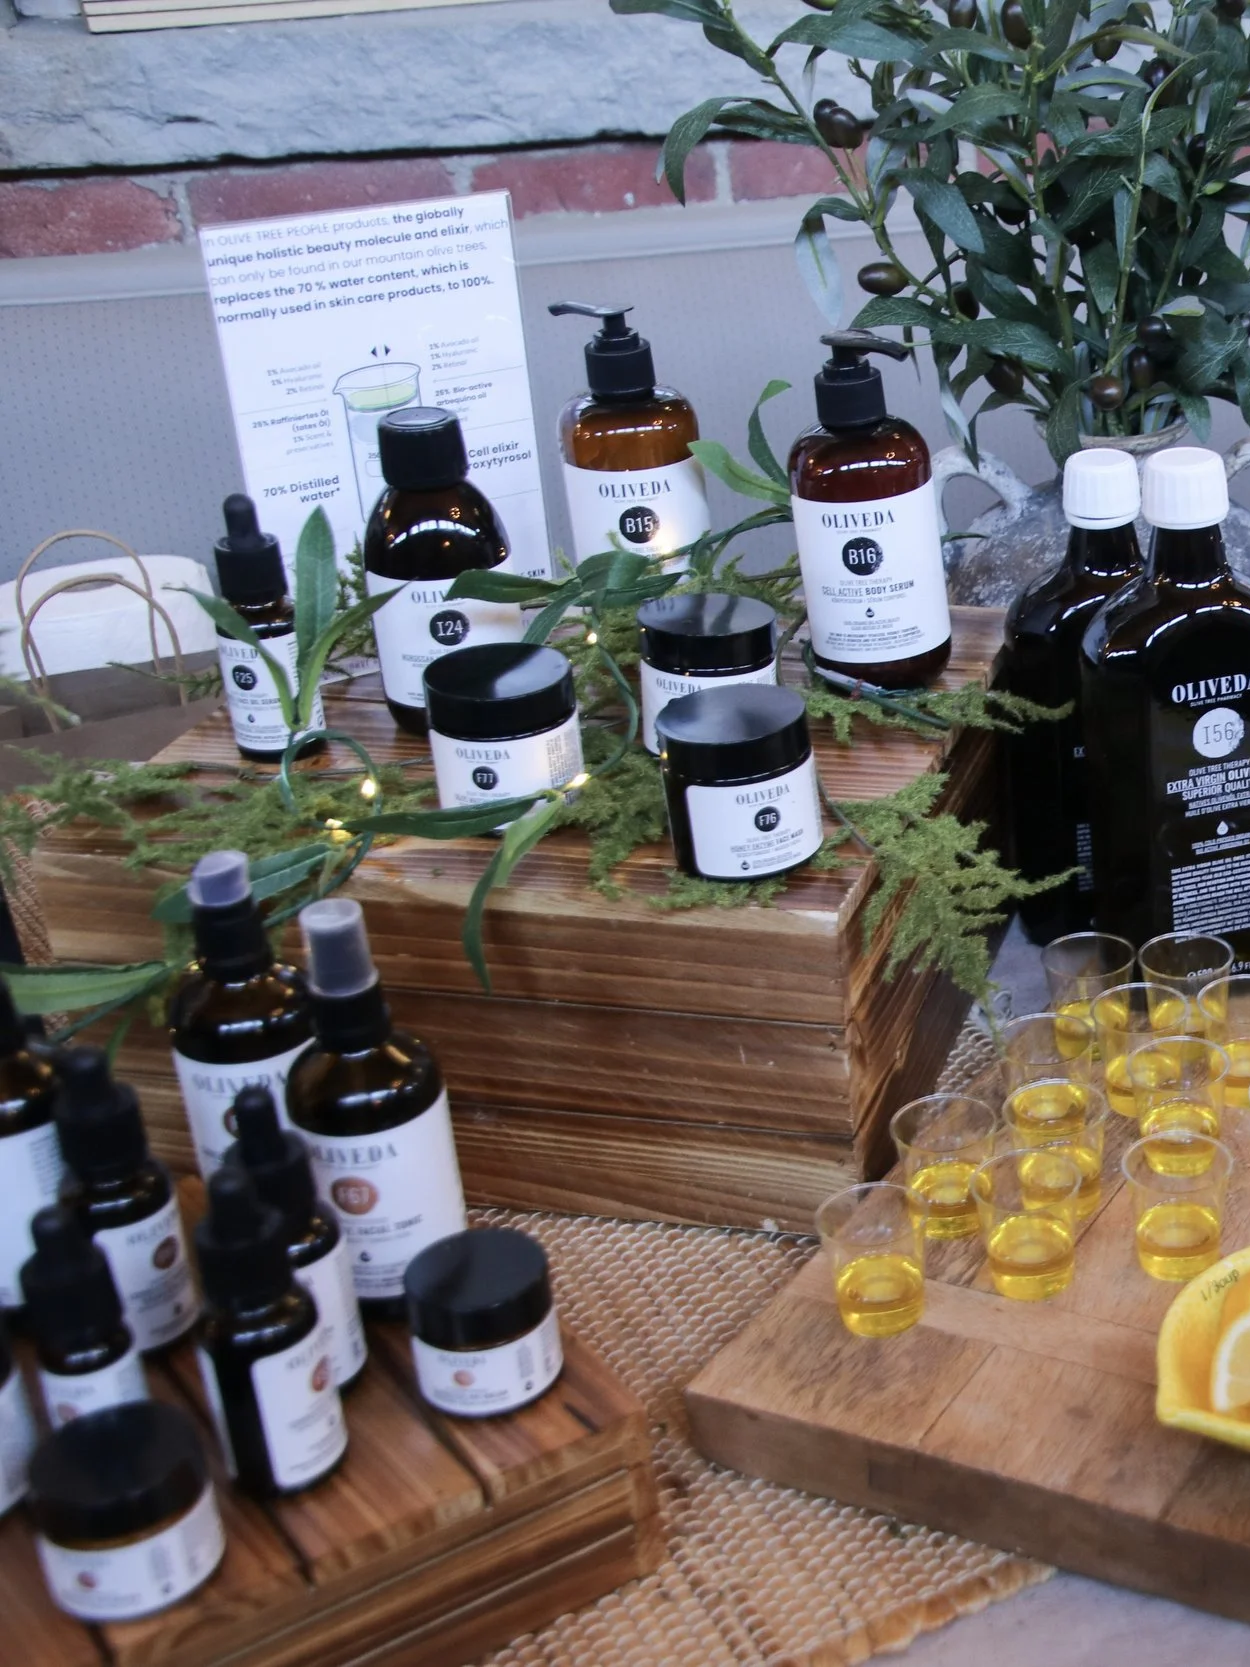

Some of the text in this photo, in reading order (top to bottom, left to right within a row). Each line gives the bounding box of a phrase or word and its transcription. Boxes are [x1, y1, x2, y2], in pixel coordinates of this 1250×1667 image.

[218, 233, 252, 247] OLIVE
[256, 228, 284, 241] TREE
[287, 223, 329, 239] PEOPLE
[393, 211, 414, 225] the
[416, 206, 465, 225] globally
[207, 219, 509, 271] unique holistic beauty molecule and elixir, which
[210, 275, 237, 287] can
[239, 270, 267, 286] only
[269, 266, 286, 280] be
[288, 260, 326, 277] found
[328, 259, 340, 271] in
[342, 257, 364, 270] our
[365, 247, 425, 266] mountain
[426, 243, 454, 258] olive
[214, 260, 470, 307] replaces the 70 % water content, which is
[217, 305, 278, 325] normally
[280, 300, 313, 317] used
[314, 298, 327, 311] in
[329, 292, 356, 308] skin
[357, 290, 385, 305] care
[388, 282, 447, 302] products,
[447, 279, 460, 291] to
[468, 441, 520, 459] Cell elixir
[467, 450, 532, 472] roxytyrosol
[263, 475, 341, 498] 70% Distilled
[599, 479, 672, 498] OLIVEDA
[625, 516, 654, 533] B15
[822, 509, 895, 529] OLIVEDA
[848, 547, 877, 565] B16
[865, 586, 886, 596] BODY
[890, 579, 915, 593] SERUM
[1217, 693, 1243, 702] PHARMACY
[455, 747, 511, 761] OLIVEDA
[1189, 758, 1250, 777] OLIVE TREE THERAPY
[1166, 778, 1194, 795] EXTRA
[1195, 771, 1226, 788] VIRGIN
[1182, 784, 1223, 801] SUPERIOR
[735, 784, 790, 805] OLIVEDA
